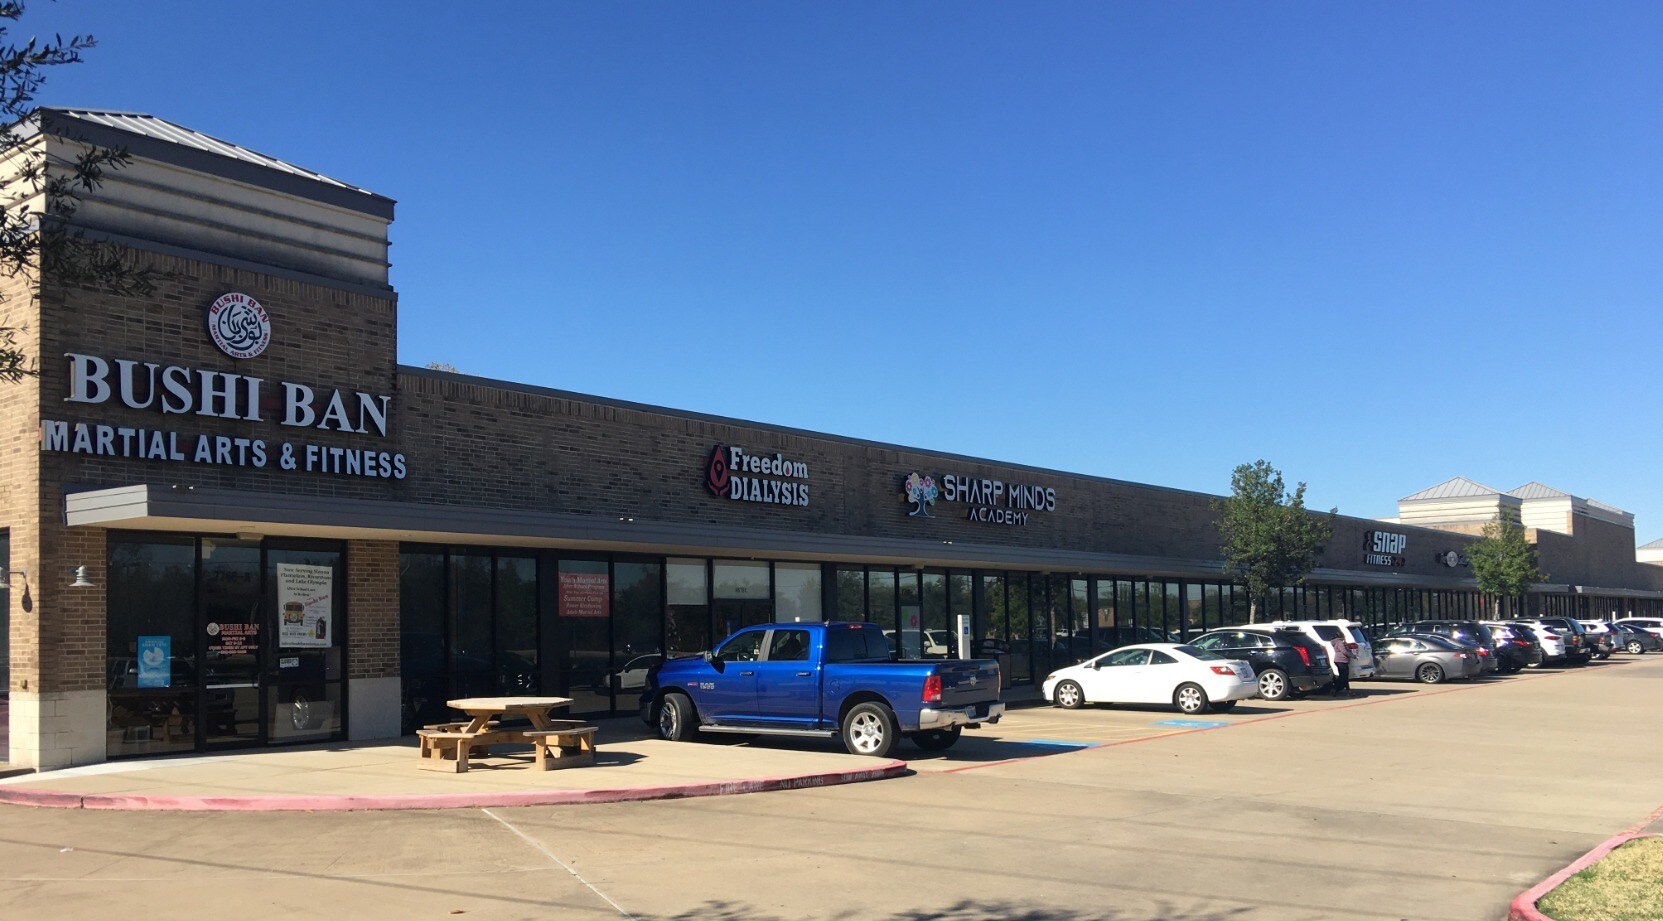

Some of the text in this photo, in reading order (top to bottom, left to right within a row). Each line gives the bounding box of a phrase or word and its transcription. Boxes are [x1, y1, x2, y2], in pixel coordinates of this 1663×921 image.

[211, 294, 269, 323] BUSHI BAN
[211, 324, 229, 352] MARTIAL
[254, 332, 268, 354] FITNESS
[63, 352, 391, 438] BUSHI BAN
[40, 419, 407, 479] MARTIAL ARTS & FITNESS
[729, 447, 808, 479] Freedom
[730, 475, 809, 507] DIALYSIS
[943, 474, 1056, 512] SHARP MINDS
[969, 507, 1029, 526] ACADEMY
[1366, 554, 1392, 566] FITNESS
[587, 595, 602, 603] Camp
[219, 623, 260, 631] BUSHI BAN
[793, 776, 824, 788] PARKING
